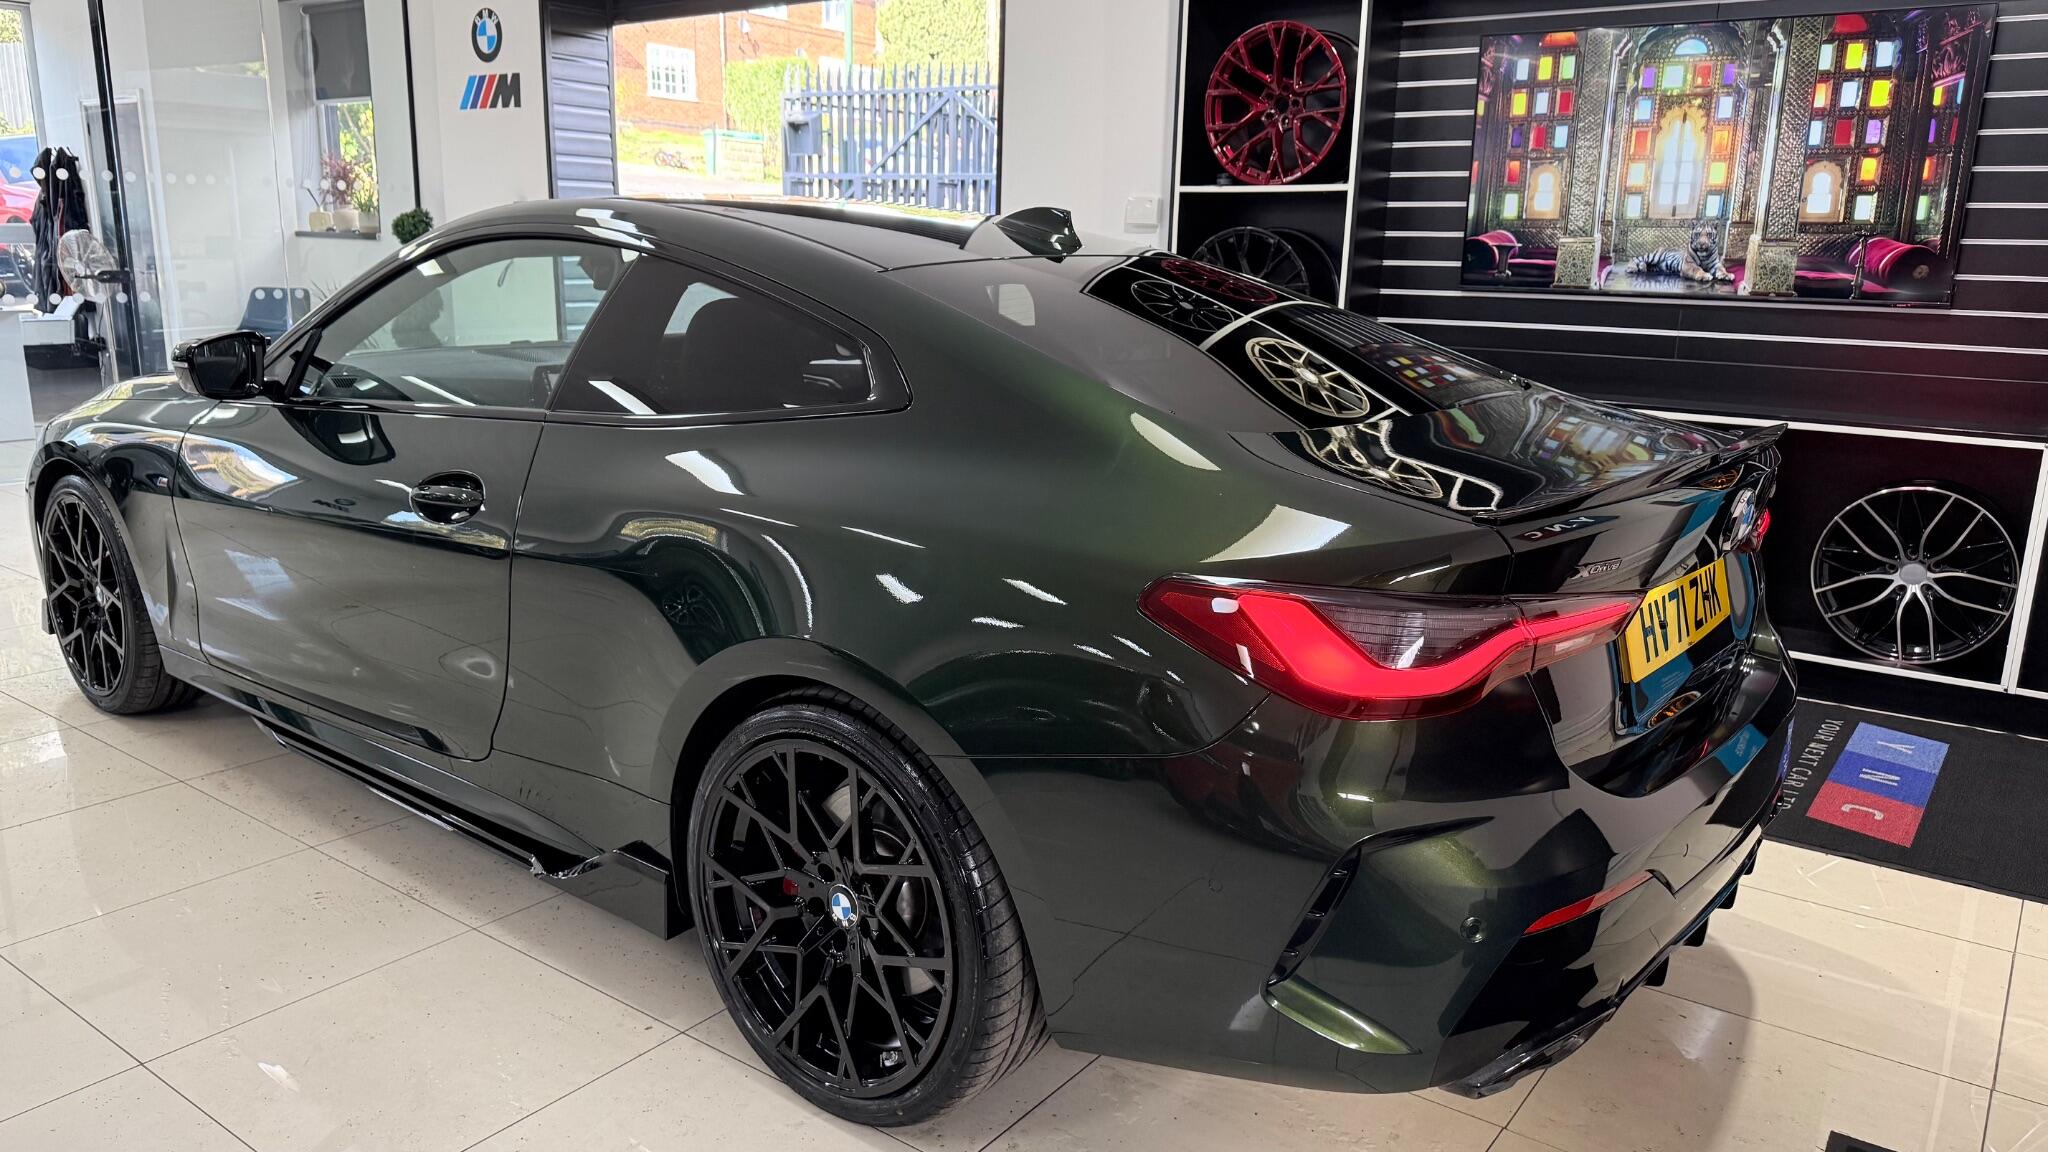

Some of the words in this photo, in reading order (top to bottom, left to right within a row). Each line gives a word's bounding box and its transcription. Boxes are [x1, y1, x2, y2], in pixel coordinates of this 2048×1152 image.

[474, 9, 499, 25] BMW
[1639, 584, 1690, 663] HV71
[1688, 563, 1722, 632] ZHK
[1813, 719, 1844, 742] YOUR
[1798, 742, 1829, 767] NEXT
[1783, 767, 1812, 788] CAR
